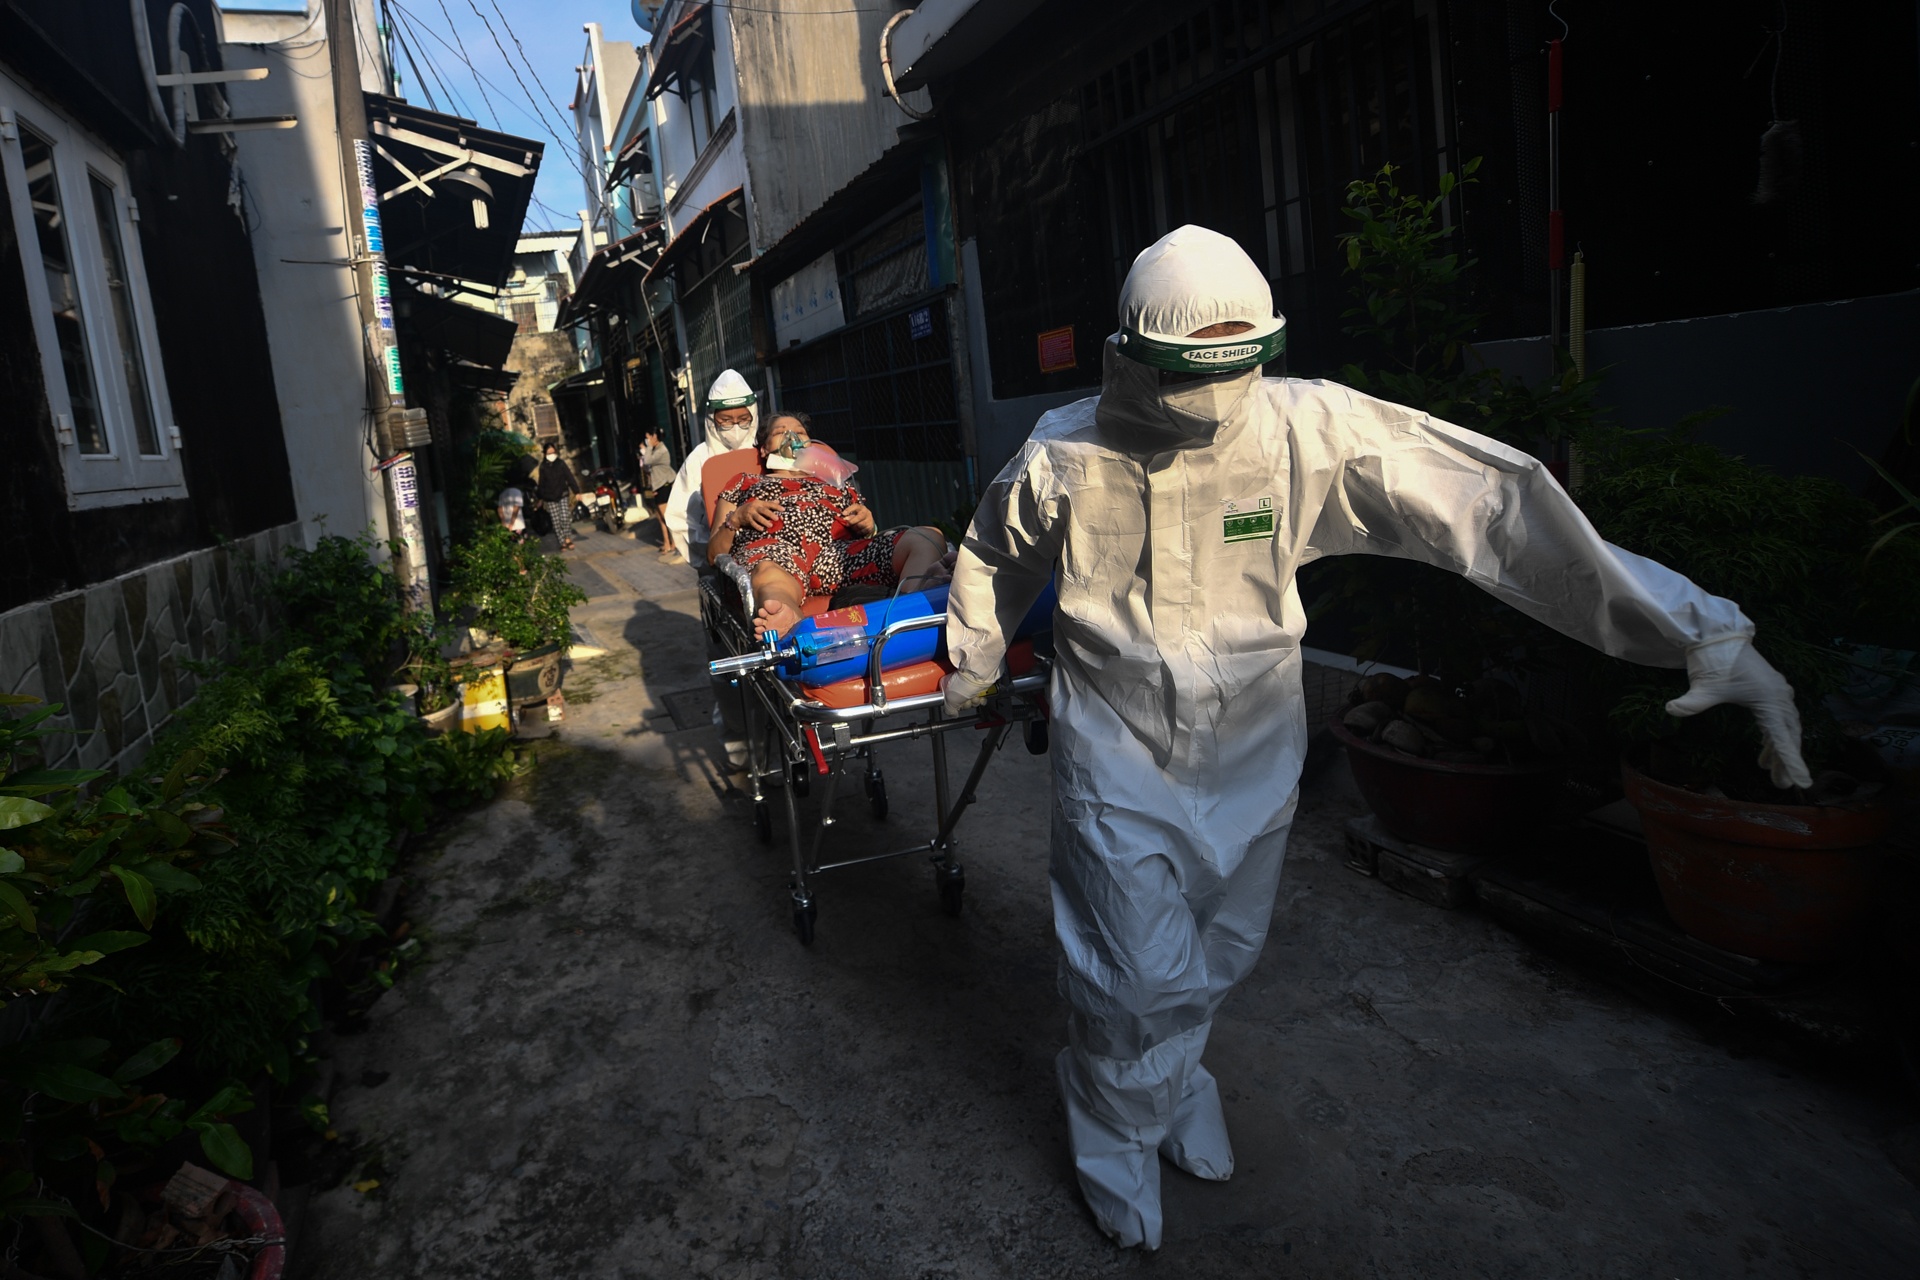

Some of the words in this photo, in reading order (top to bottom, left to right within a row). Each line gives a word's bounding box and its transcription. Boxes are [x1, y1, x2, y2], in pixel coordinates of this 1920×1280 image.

[1188, 351, 1219, 360] FACE
[1221, 346, 1258, 358] SHIELD
[1215, 359, 1244, 368] Protective
